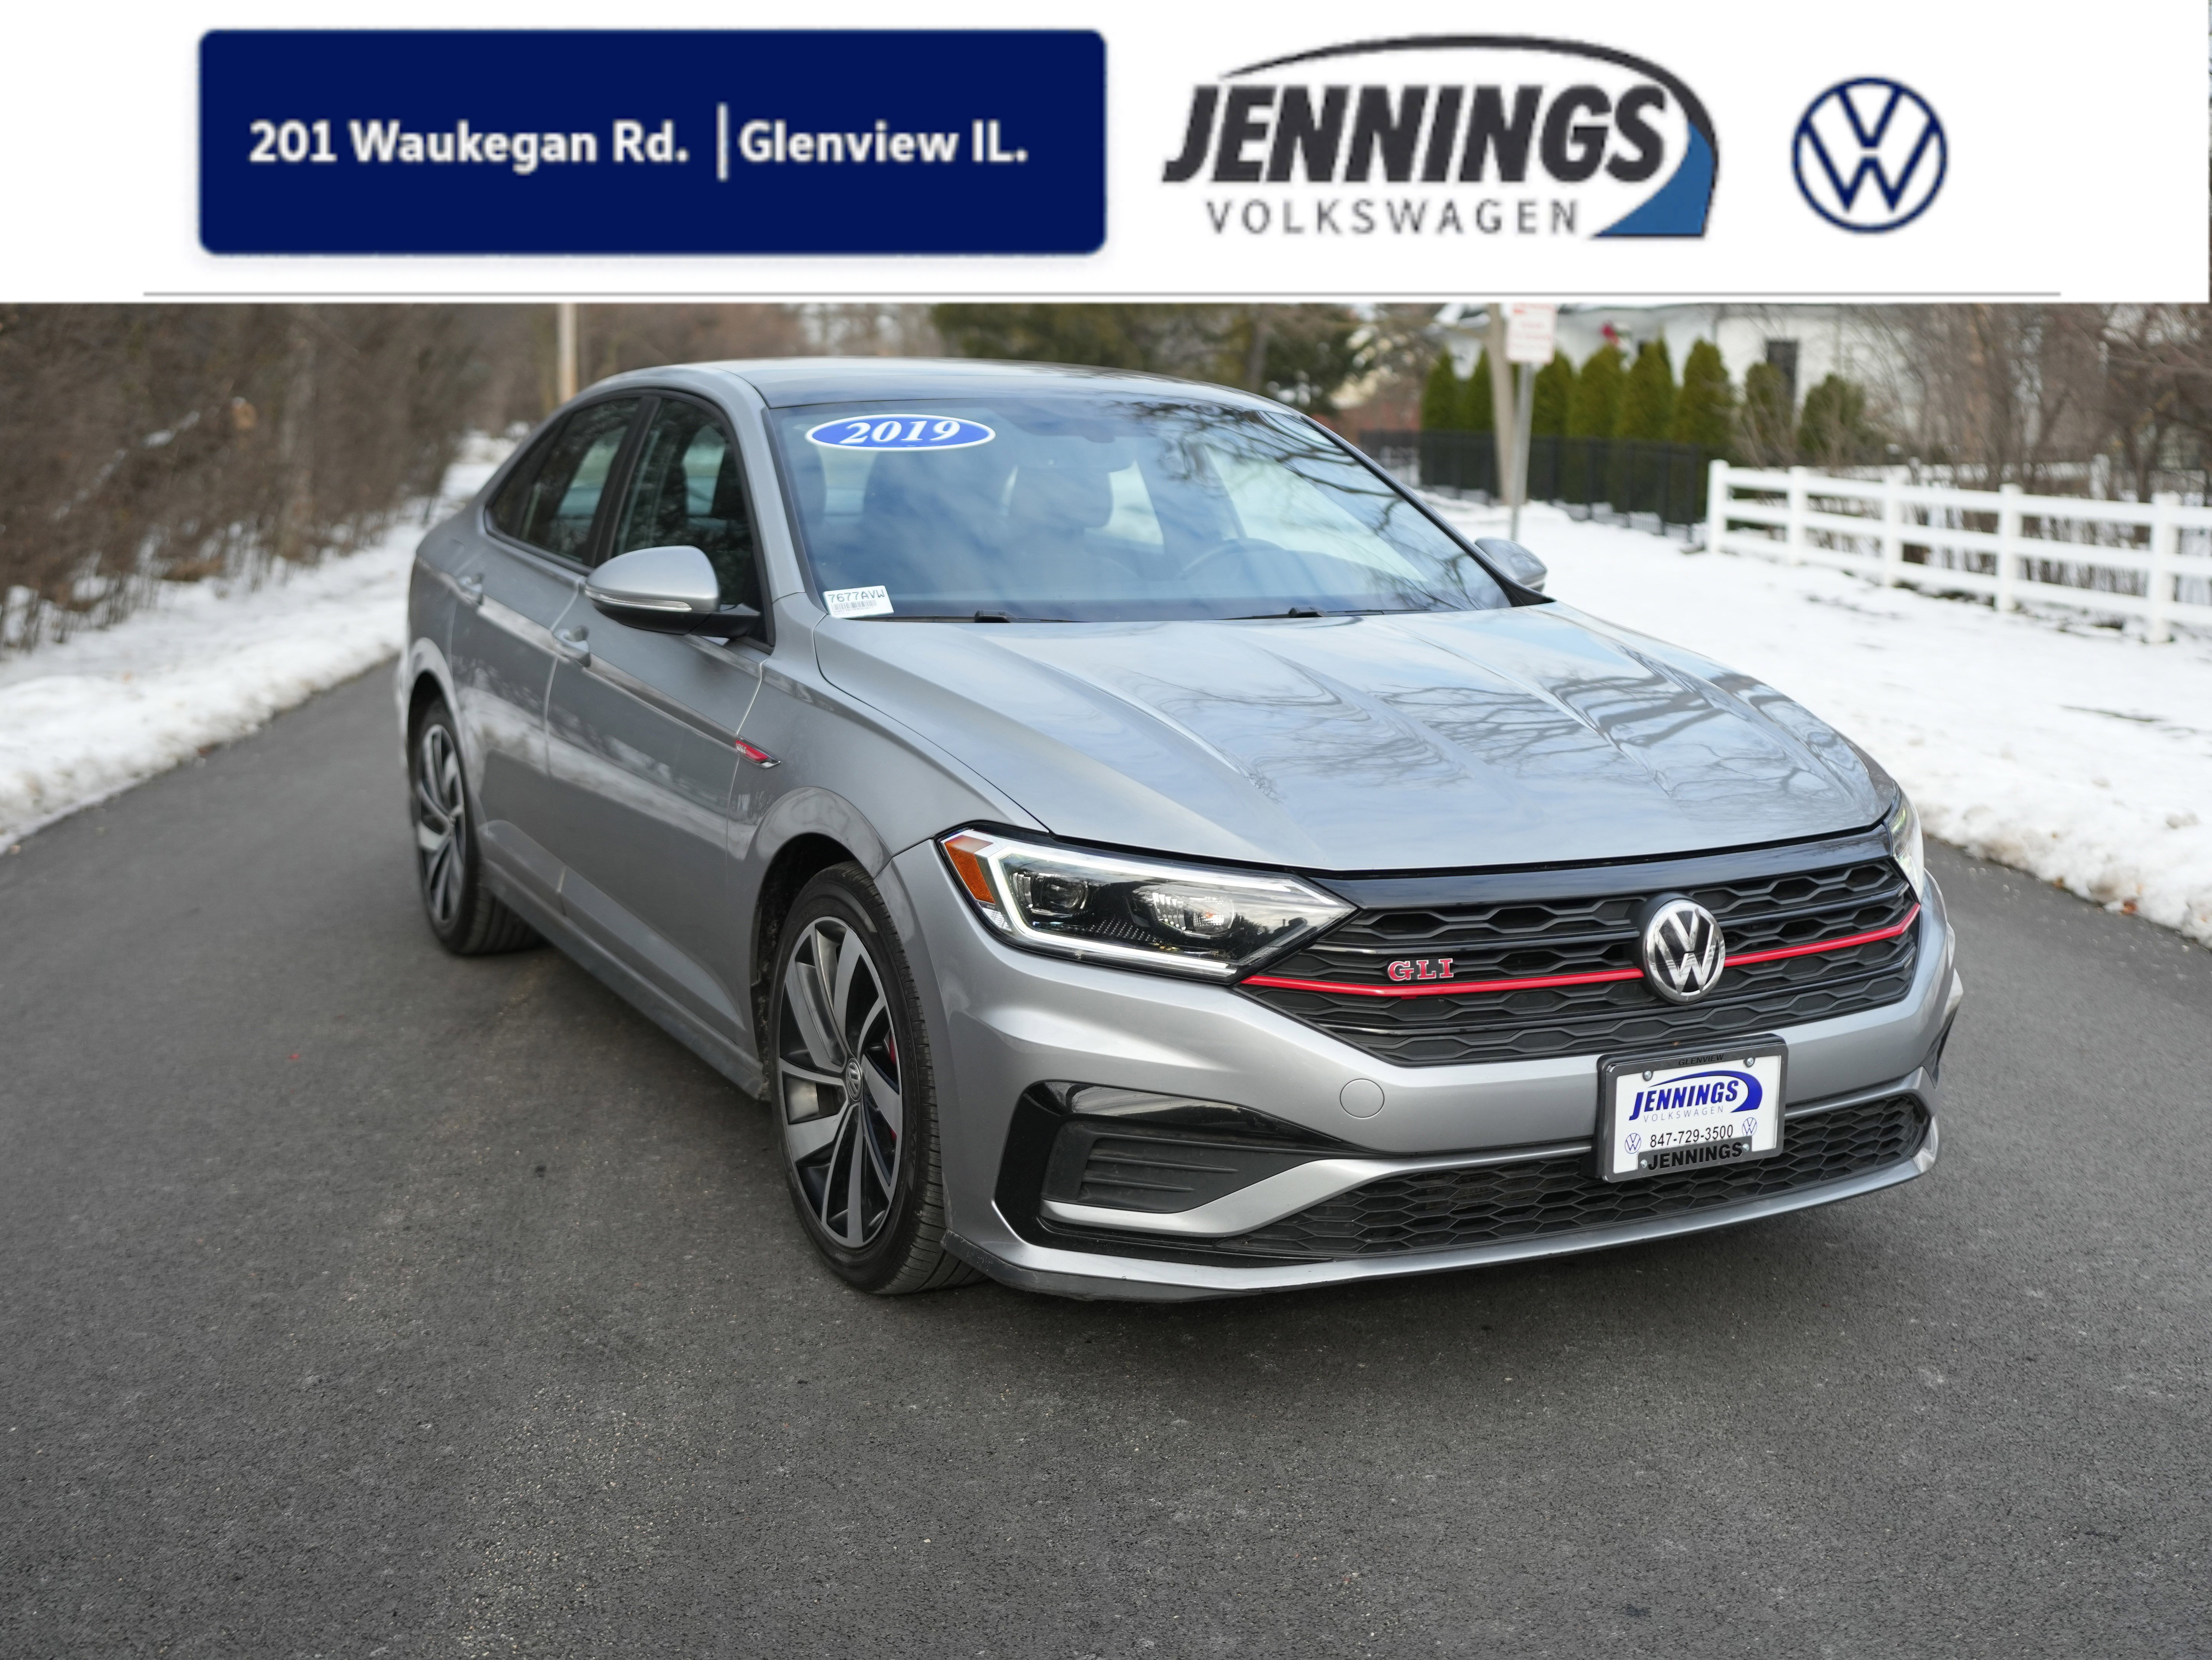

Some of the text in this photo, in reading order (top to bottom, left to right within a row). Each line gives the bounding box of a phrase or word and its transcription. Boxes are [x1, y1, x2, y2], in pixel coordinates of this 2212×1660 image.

[839, 420, 961, 444] 2019
[828, 589, 885, 603] 7677AVW
[1388, 958, 1454, 981] GLI
[1679, 1054, 1724, 1066] GLENVIEW
[1629, 1080, 1739, 1121] JENNINGS
[1644, 1105, 1723, 1122] VOLKSWAGEN
[1650, 1124, 1733, 1148] 847-729-3500
[1648, 1142, 1742, 1170] JENNINGS
